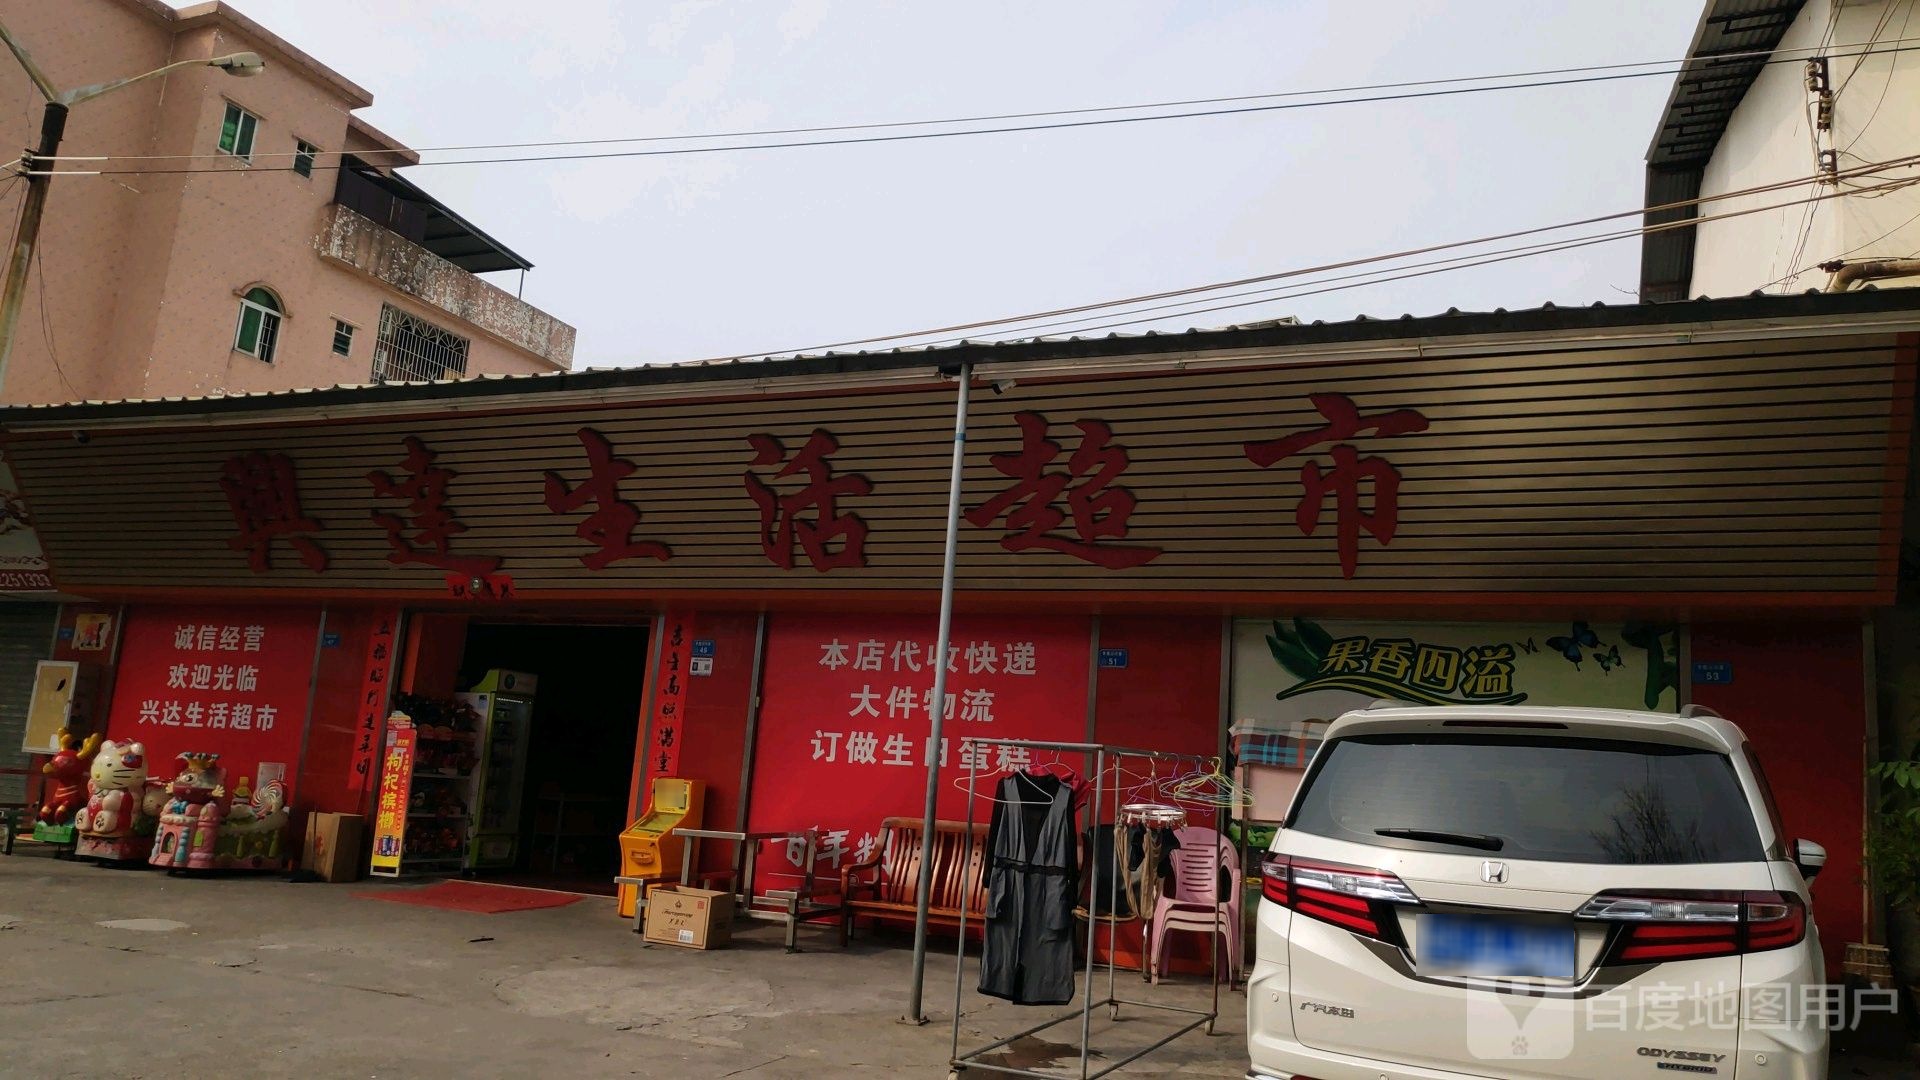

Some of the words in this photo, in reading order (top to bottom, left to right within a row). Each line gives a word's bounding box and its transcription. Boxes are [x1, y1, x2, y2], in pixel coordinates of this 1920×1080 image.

[174, 624, 265, 652] 诚信经营
[819, 638, 1037, 675] 本店代收快递
[167, 663, 260, 692] 欢迎光临
[1318, 637, 1515, 698] 果香四溢
[138, 699, 278, 732] 兴达生活超市
[848, 684, 996, 722] 大件物流
[811, 729, 1032, 774] 订做生日蛋糕
[379, 753, 402, 829] 枸杞槟榔
[1637, 1046, 1726, 1063] ODYSSEY
